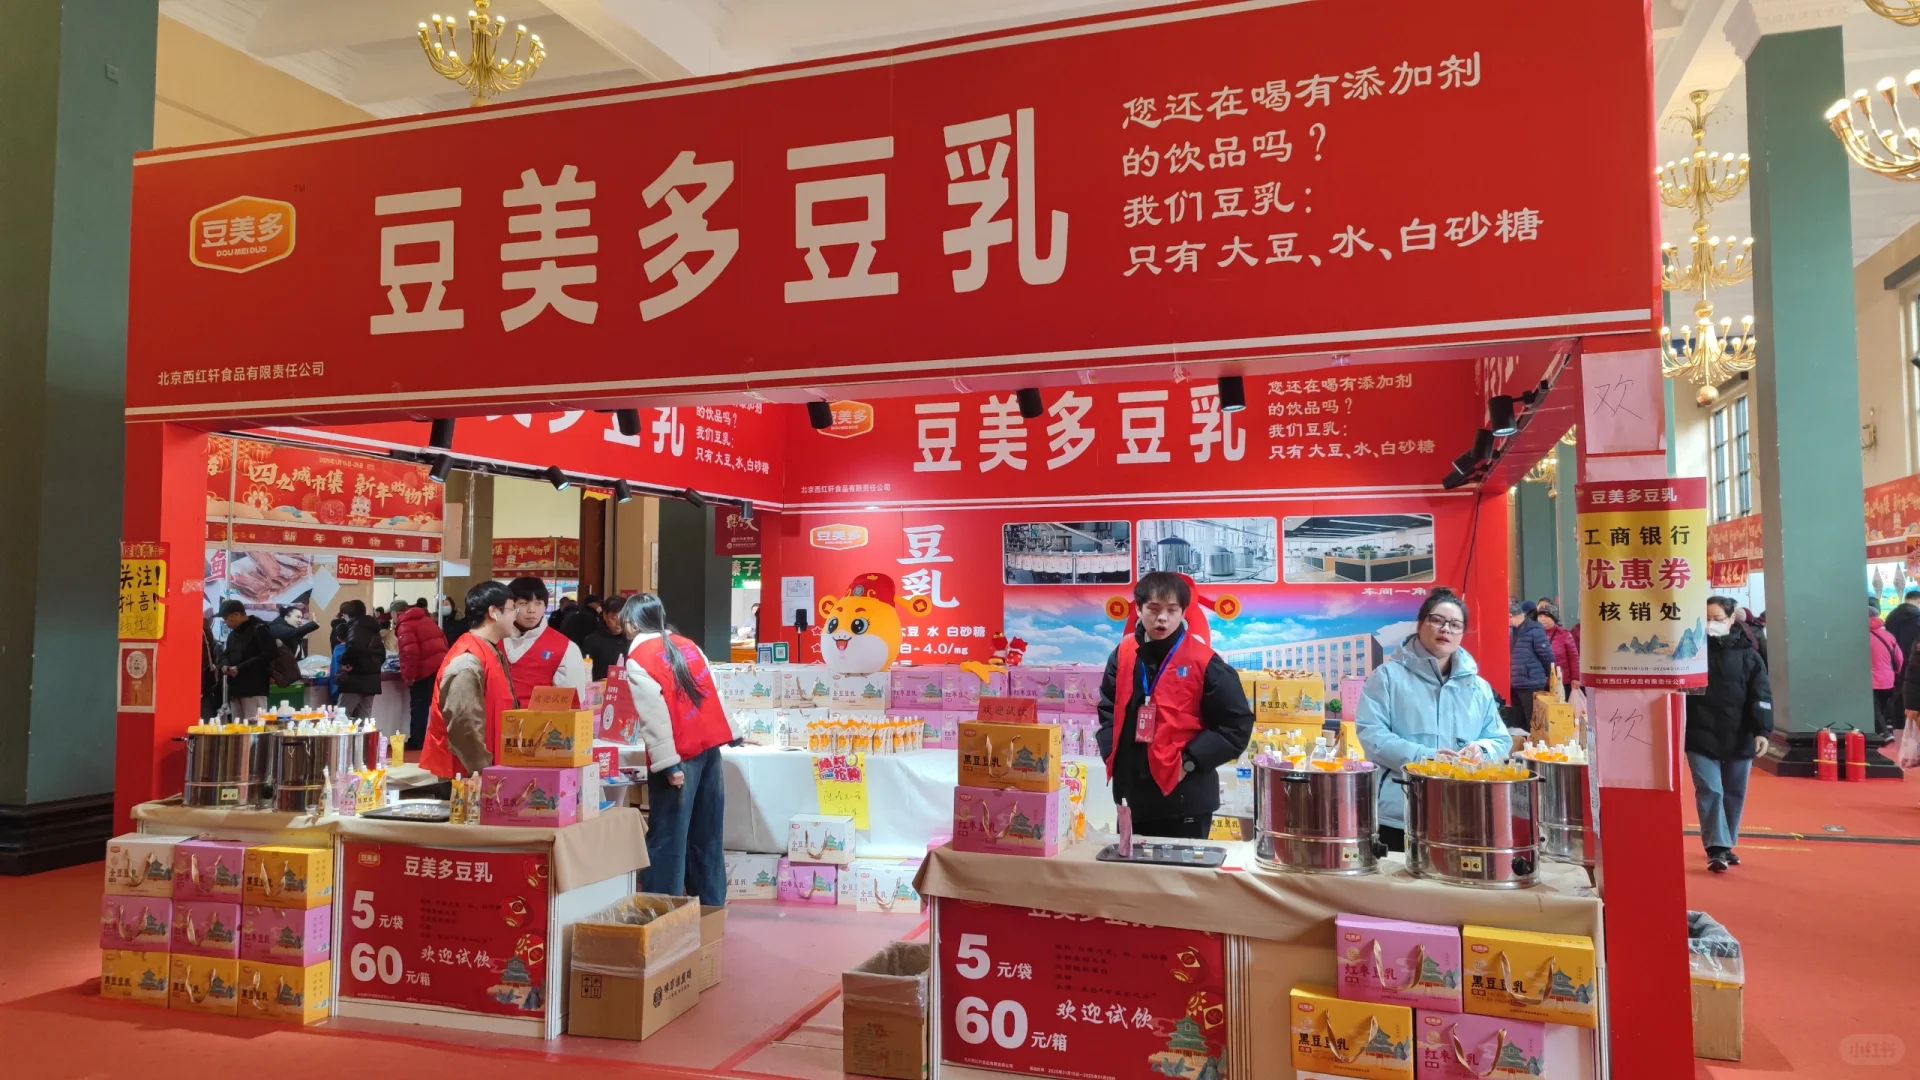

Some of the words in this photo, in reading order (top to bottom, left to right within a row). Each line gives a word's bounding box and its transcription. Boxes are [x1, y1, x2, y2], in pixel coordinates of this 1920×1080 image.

[1121, 52, 1482, 130] 您还在喝有添加剂
[1122, 122, 1327, 178] 的饮品吗?
[1122, 180, 1313, 229] 我们豆乳:
[200, 210, 285, 251] 豆美多
[368, 106, 1069, 335] 豆美多豆乳
[156, 360, 325, 387] 北京西红轩食品有限责任公司
[1268, 373, 1413, 397] 您还在喝有添加剂
[1268, 398, 1353, 418] 的饮品吗?
[913, 385, 1247, 474] 豆美多豆乳
[249, 462, 345, 496] 四九城市集
[354, 473, 436, 508] 新年购物节
[800, 483, 892, 495] 北京西红轩食品有限责任公司
[1590, 487, 1678, 505] 豆美多豆乳
[282, 530, 406, 549] 新年购物节
[1584, 525, 1691, 546] 工商银行
[338, 563, 372, 577] 50元3包
[896, 524, 960, 609] 豆乳
[1585, 557, 1692, 590] 优惠券
[1361, 587, 1427, 596] 车间一角
[1598, 601, 1682, 622] 核销处
[926, 626, 940, 638] 水
[946, 625, 986, 638] 白砂糖
[983, 705, 1028, 717] 欢迎试饮
[404, 855, 493, 883] 豆美多豆乳
[351, 889, 375, 929] 5
[378, 914, 404, 930] 元/袋
[350, 942, 403, 985] 60
[405, 970, 431, 986] 元/箱
[421, 945, 491, 969] 欢迎试饮
[956, 933, 991, 980] 5
[997, 962, 1033, 980] 元/袋
[955, 996, 1028, 1049] 60
[1030, 1031, 1067, 1052] 元/箱
[1056, 999, 1154, 1030] 欢迎试饮
